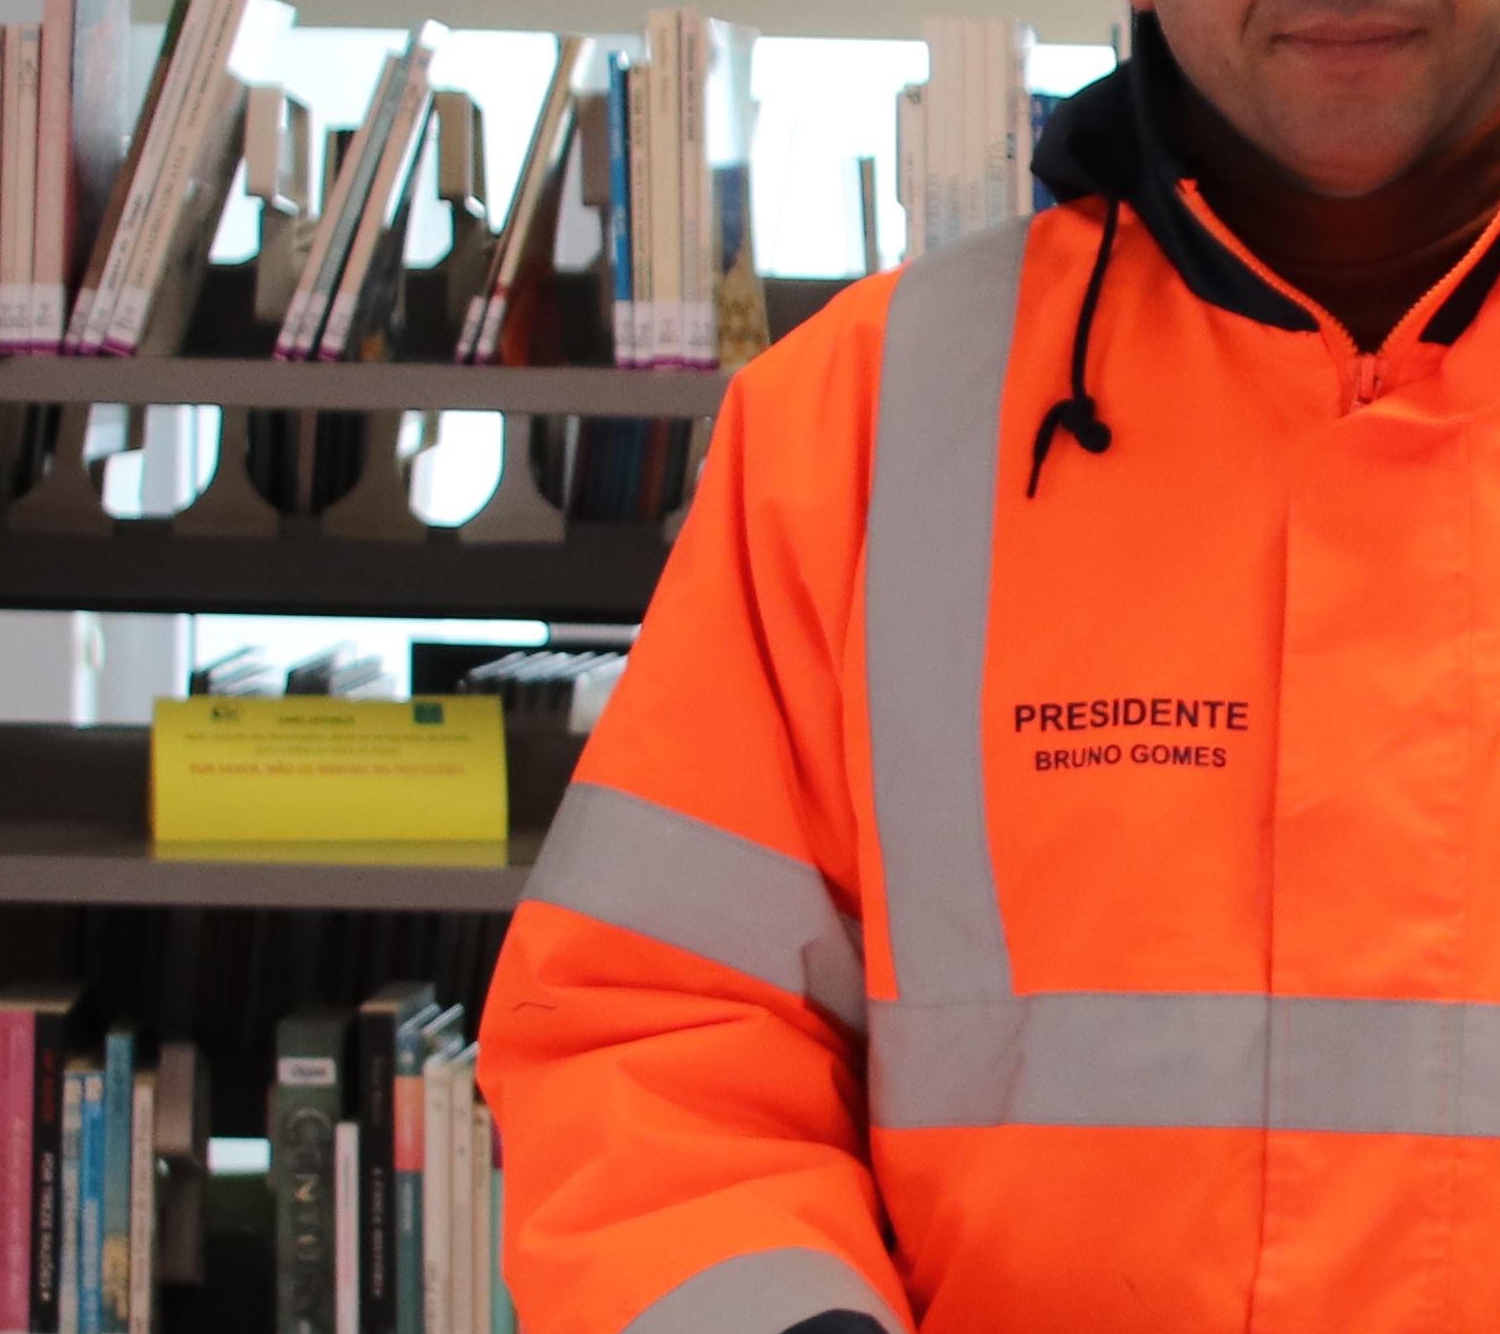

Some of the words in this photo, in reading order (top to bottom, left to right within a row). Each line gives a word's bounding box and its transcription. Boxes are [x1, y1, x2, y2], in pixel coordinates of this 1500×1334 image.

[1015, 698, 1249, 733] PRESIDENTE
[1034, 744, 1122, 772] BRUNO
[1130, 743, 1227, 768] GOMES
